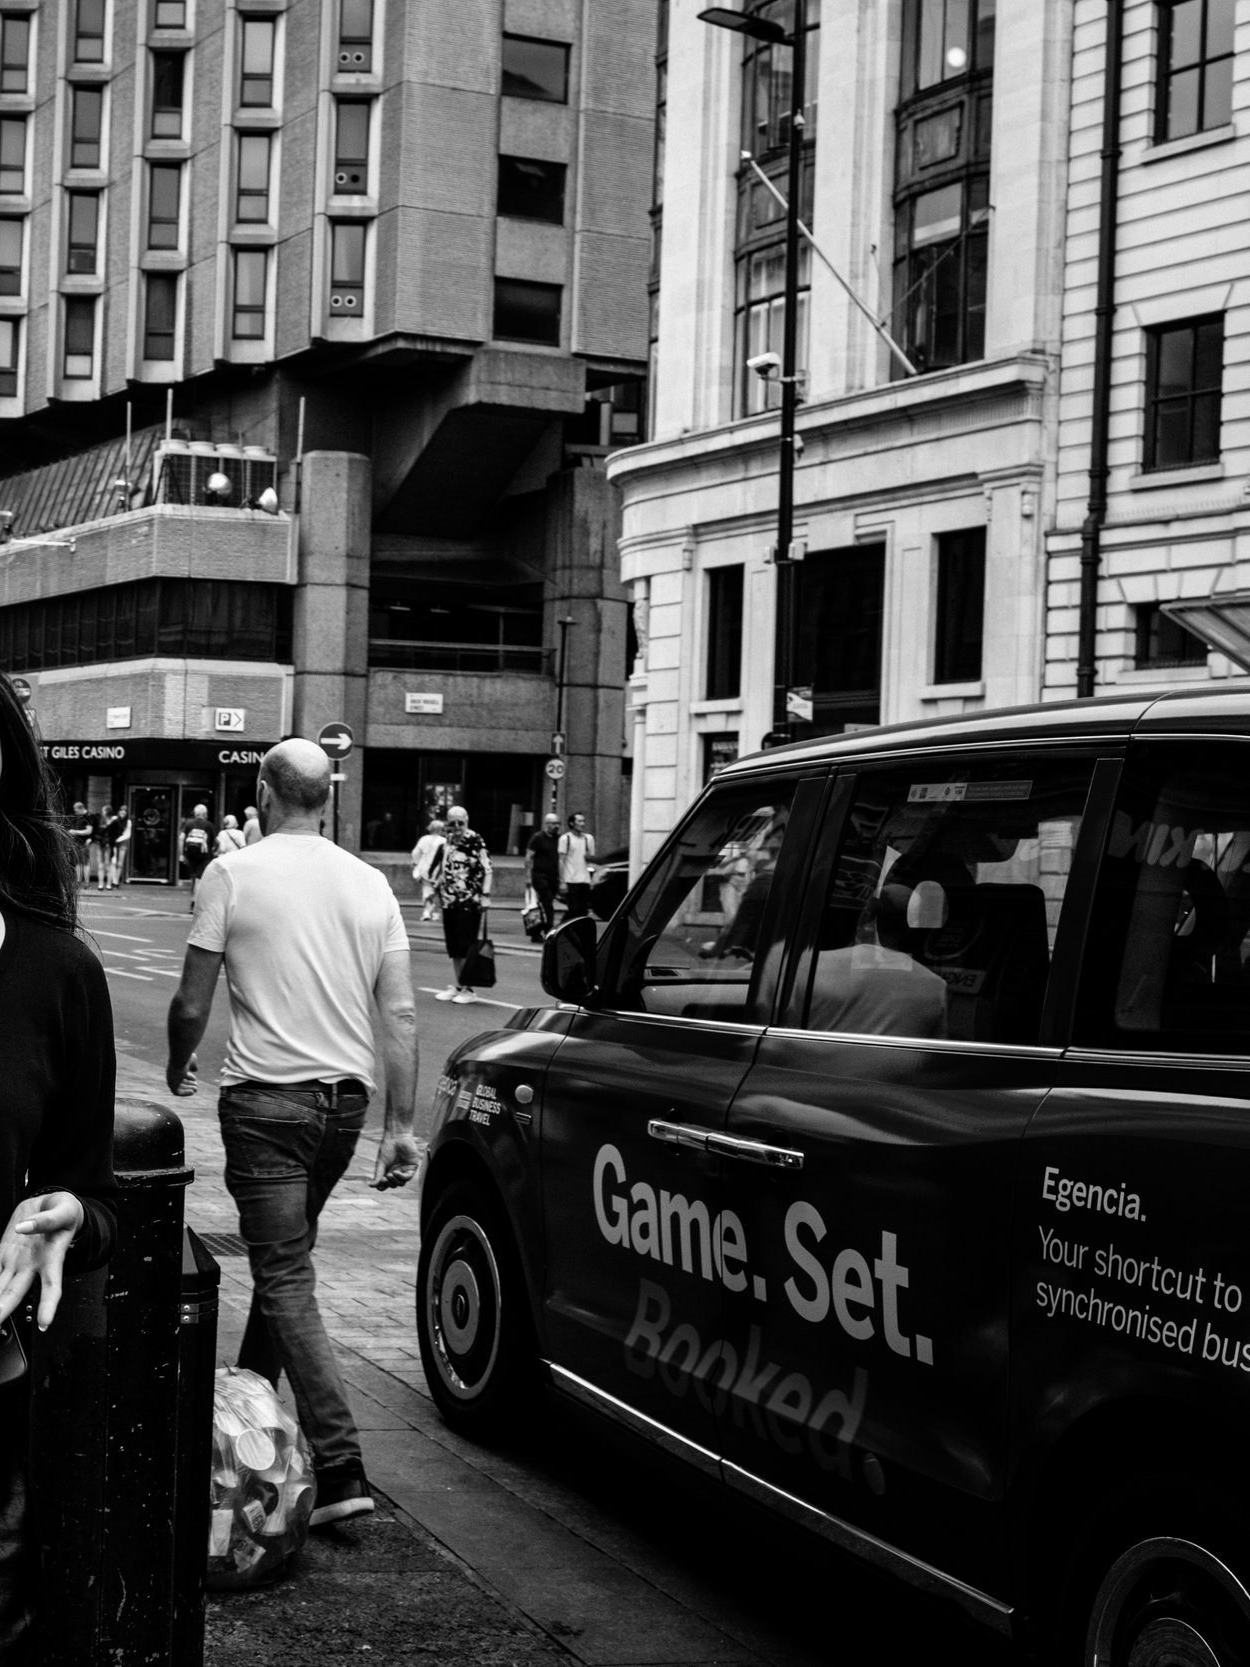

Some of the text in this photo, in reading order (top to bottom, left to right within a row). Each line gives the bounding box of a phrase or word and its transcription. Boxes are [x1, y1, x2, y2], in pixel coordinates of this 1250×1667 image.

[51, 746, 80, 760] GILES
[82, 745, 126, 760] CASINO
[218, 750, 265, 765] CASIN
[548, 764, 565, 774] 20
[475, 1083, 497, 1100] GLOBAL
[471, 1096, 502, 1115] BUSINESS
[468, 1108, 491, 1127] TRAVEL
[1042, 1165, 1147, 1223] Egencia.
[593, 1143, 935, 1367] Game. Set.
[1038, 1225, 1243, 1313] Your shortcut to
[1036, 1281, 1198, 1355] synchronised
[623, 1276, 886, 1497] Booked.
